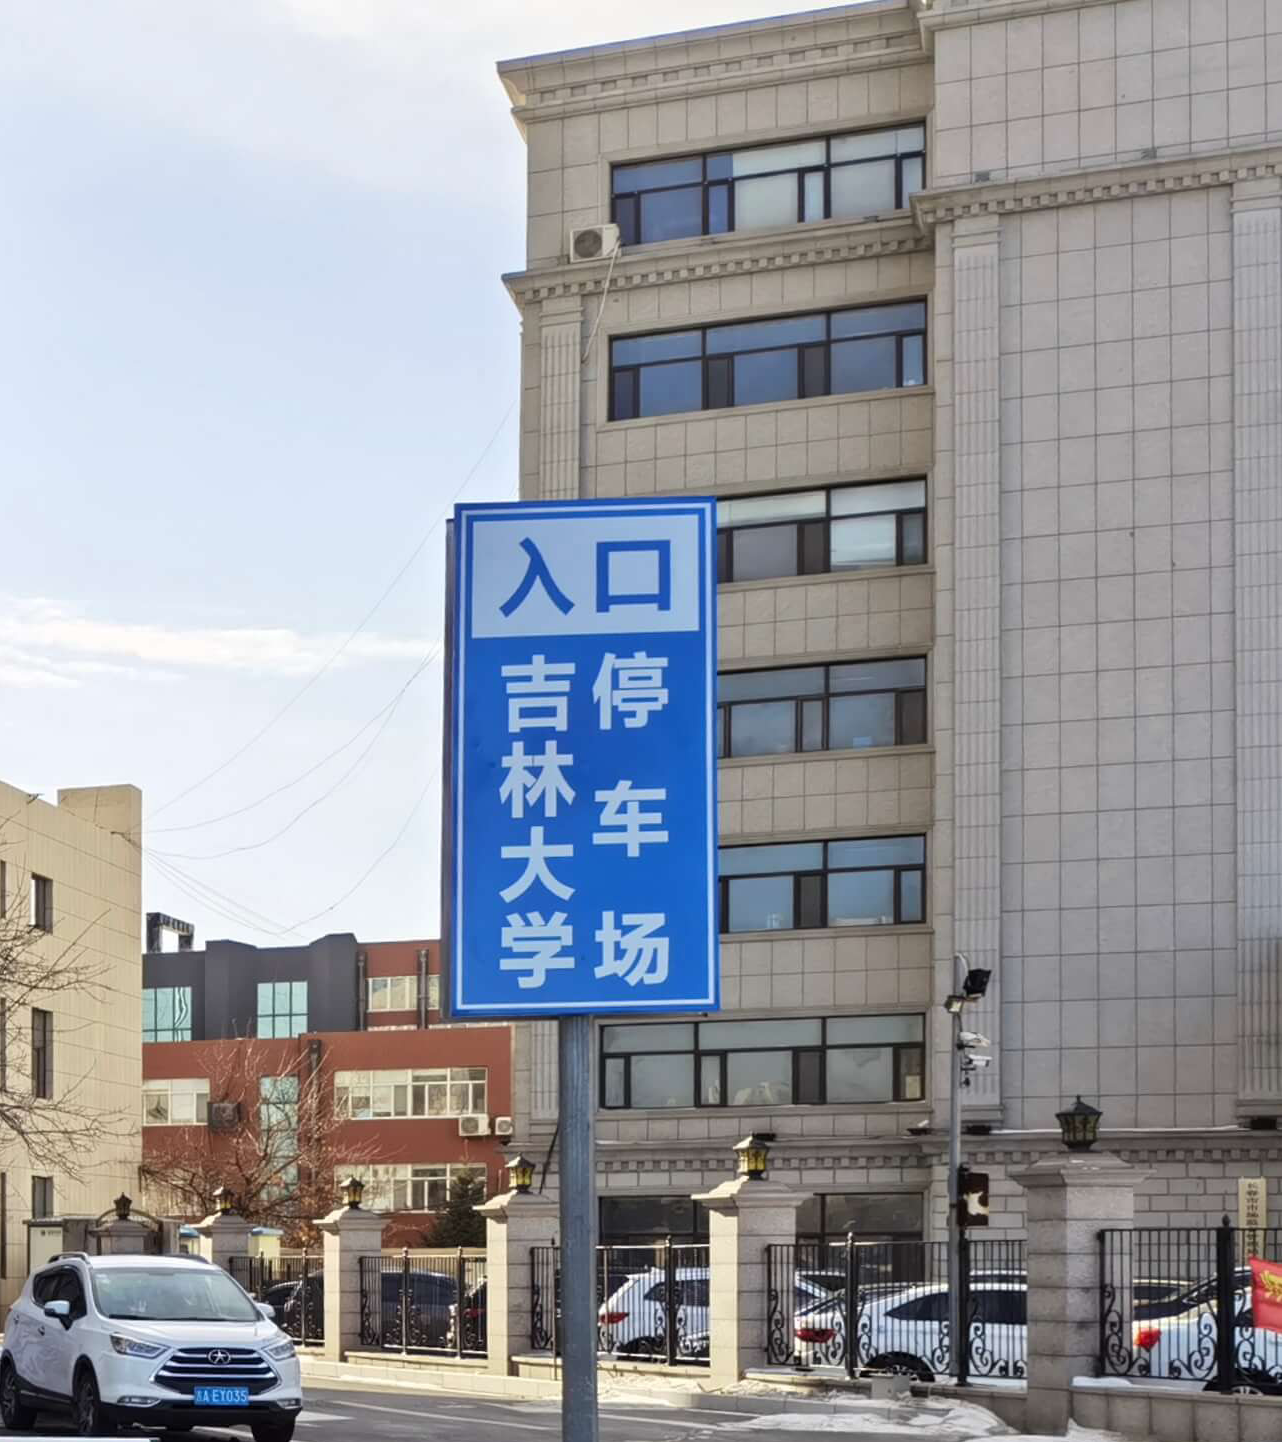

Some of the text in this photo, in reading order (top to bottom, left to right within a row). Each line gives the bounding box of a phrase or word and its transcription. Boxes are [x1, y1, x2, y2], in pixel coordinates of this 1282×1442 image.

[499, 537, 671, 618] 入口
[499, 654, 576, 988] 吉林大学
[592, 651, 669, 987] 停车场
